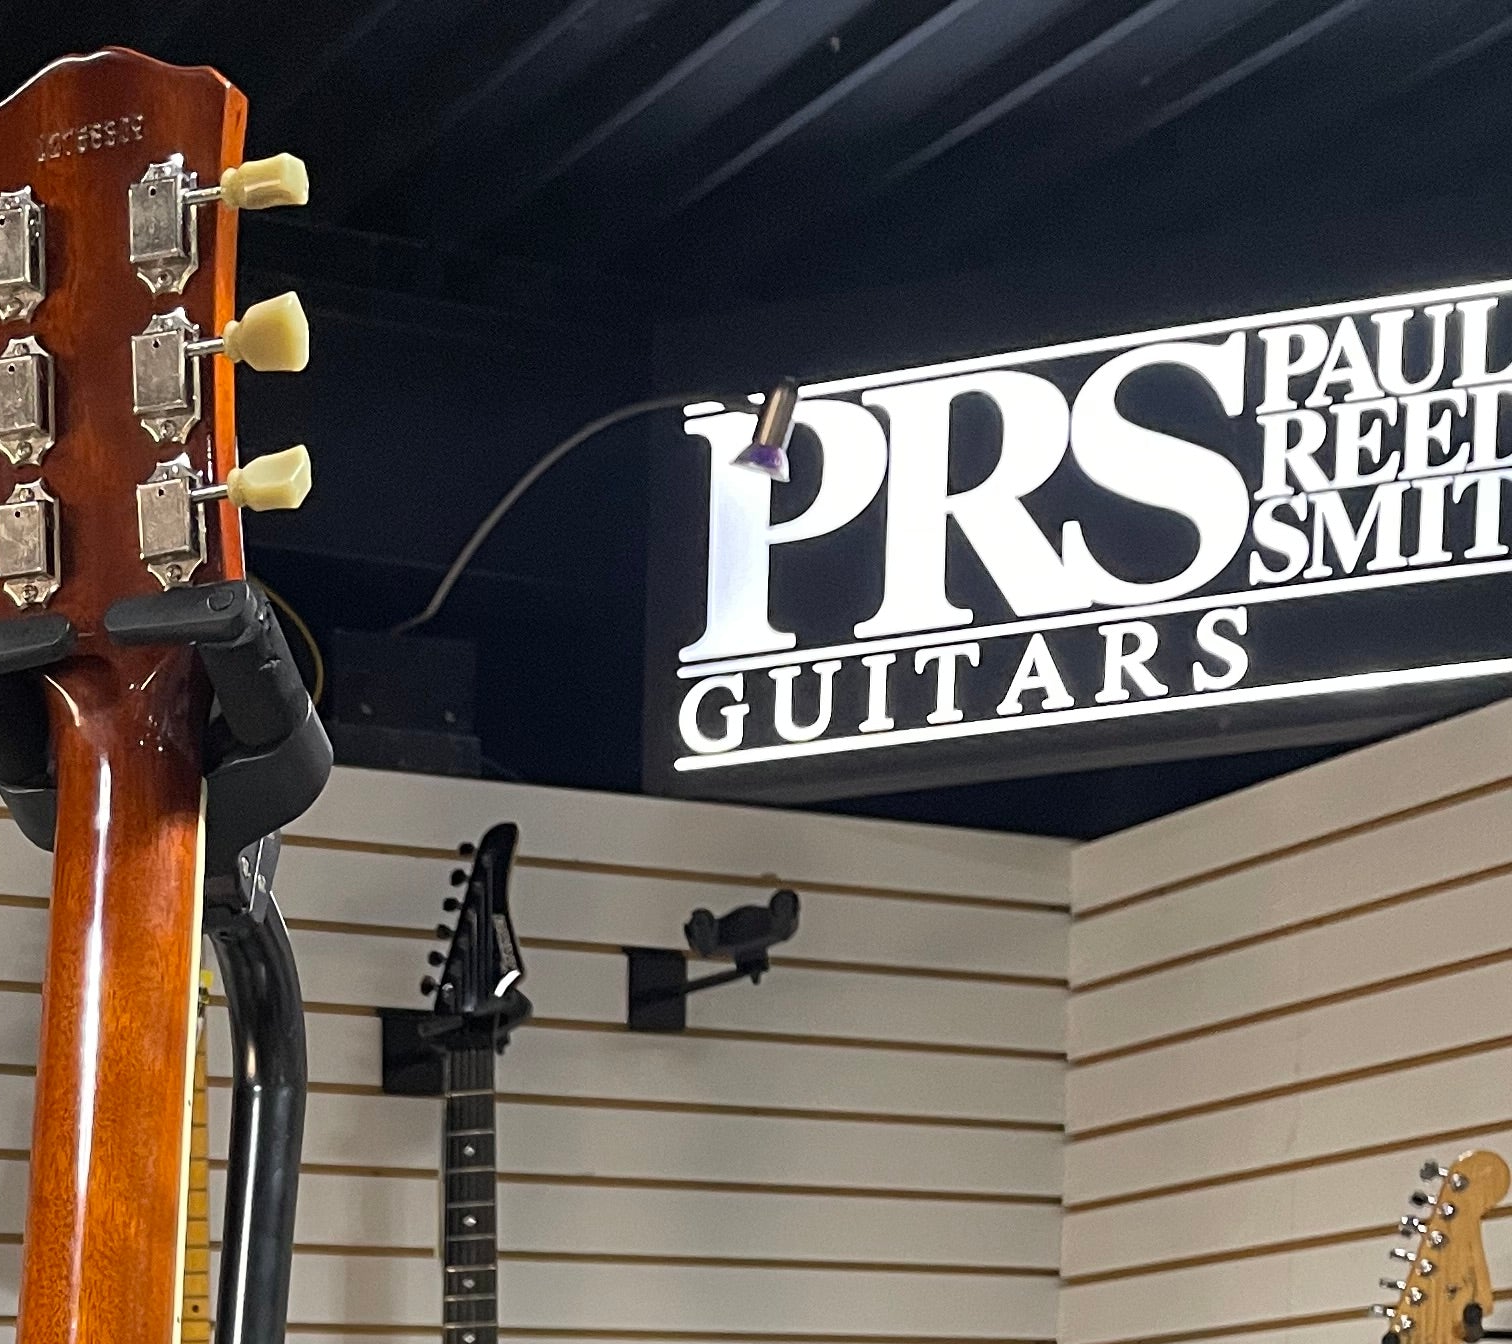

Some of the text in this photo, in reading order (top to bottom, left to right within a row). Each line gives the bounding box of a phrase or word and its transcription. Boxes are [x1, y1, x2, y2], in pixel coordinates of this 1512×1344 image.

[1256, 297, 1512, 415] PAUL
[680, 332, 1249, 661] PRS
[679, 605, 1248, 754] GUITARS
